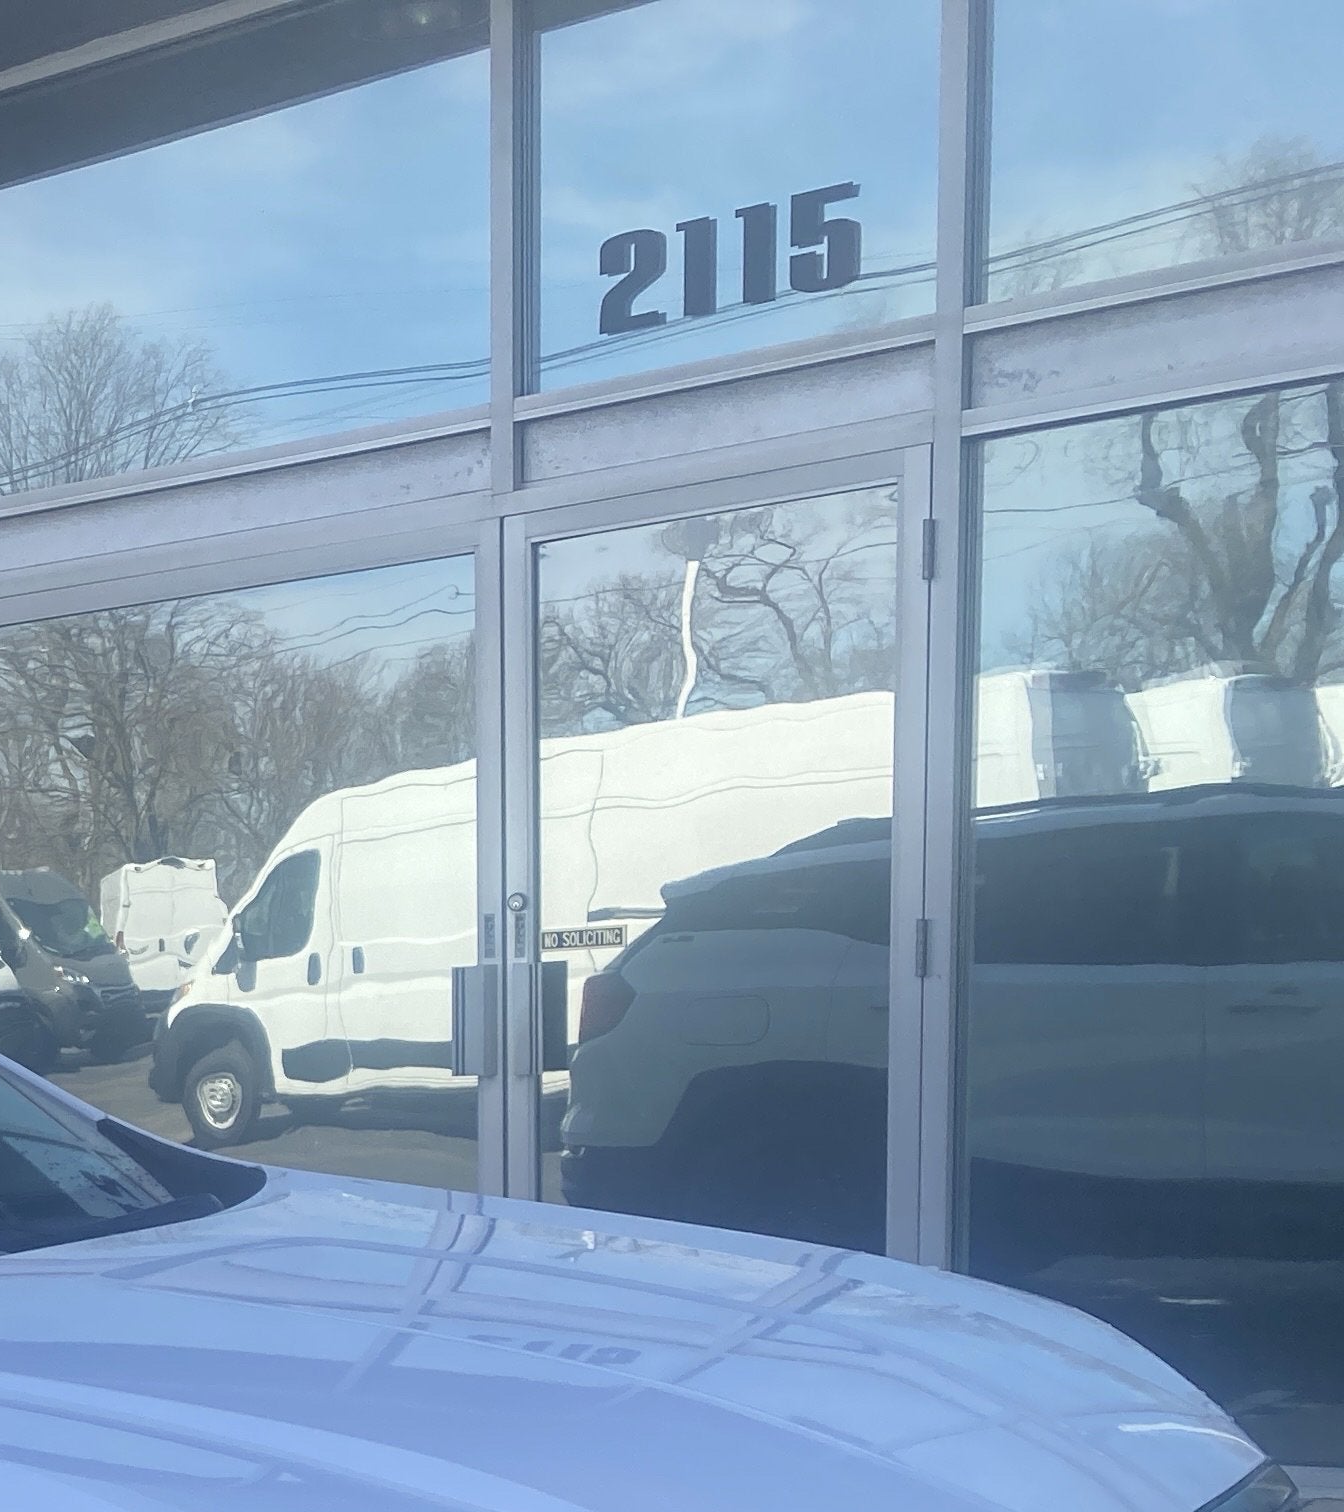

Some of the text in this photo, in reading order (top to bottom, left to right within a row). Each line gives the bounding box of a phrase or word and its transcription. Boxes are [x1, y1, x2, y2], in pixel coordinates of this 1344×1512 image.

[599, 181, 862, 336] 2115
[545, 930, 620, 948] NO SOLICITING
